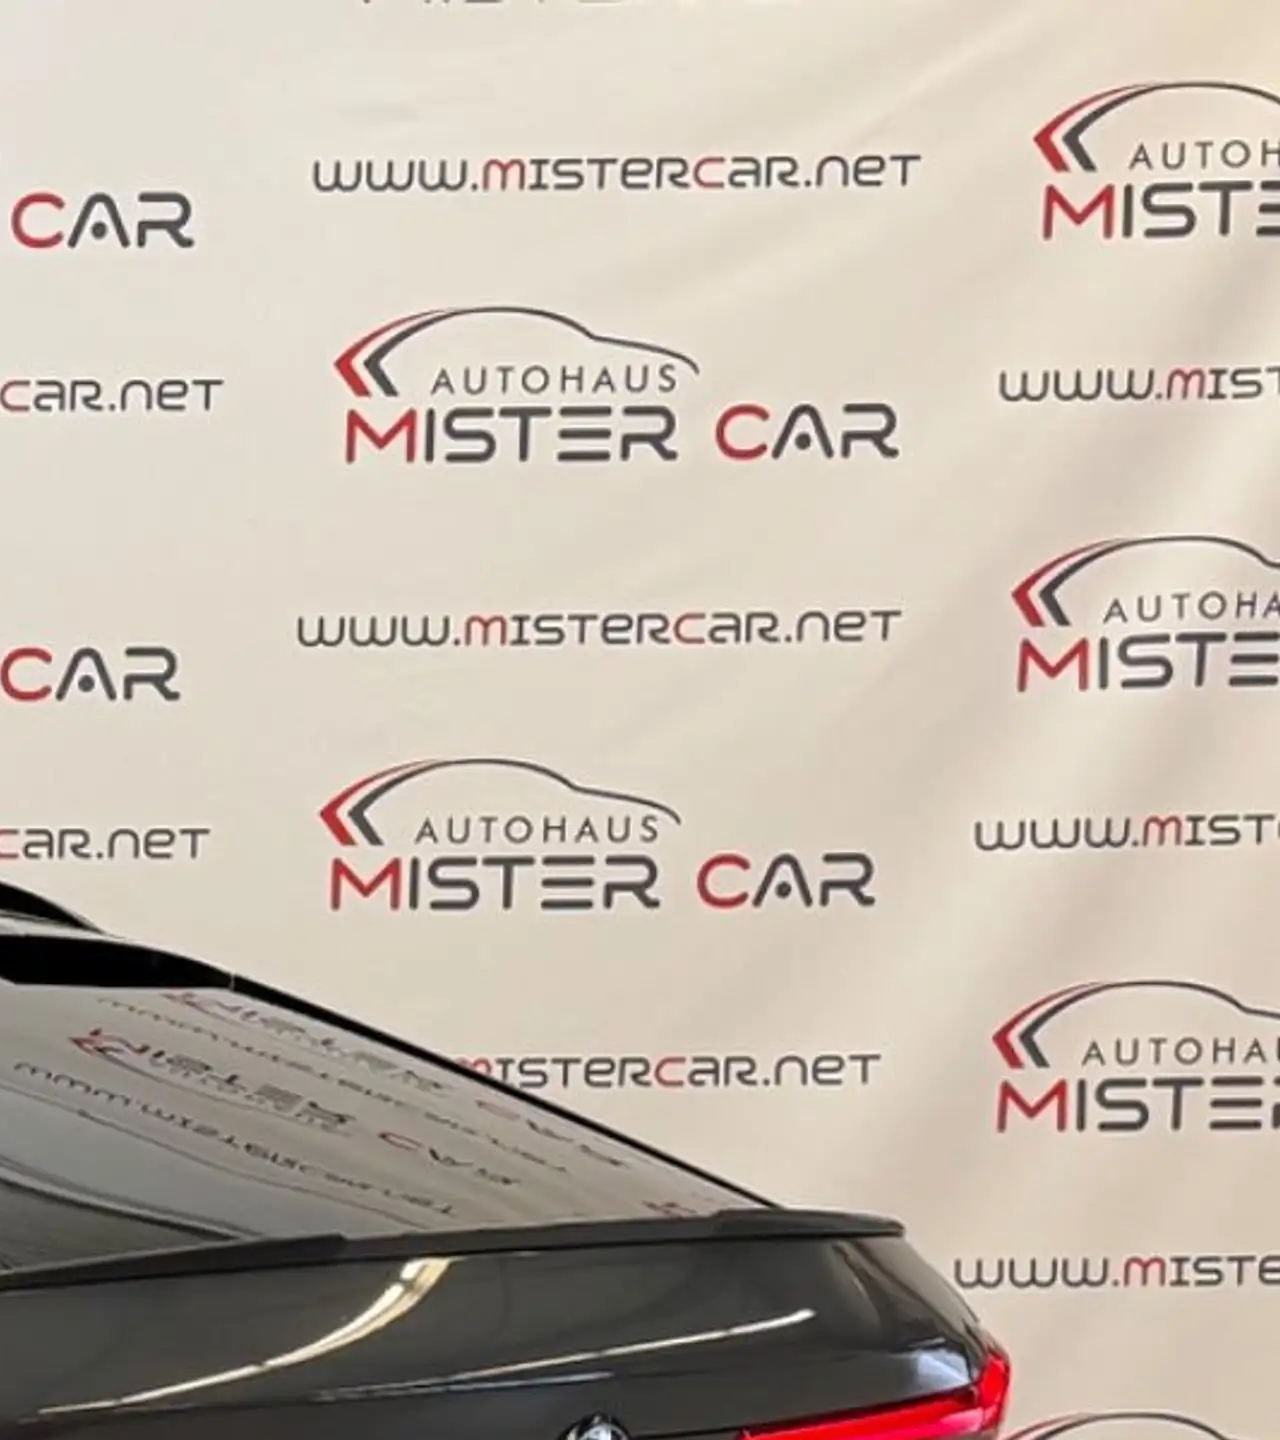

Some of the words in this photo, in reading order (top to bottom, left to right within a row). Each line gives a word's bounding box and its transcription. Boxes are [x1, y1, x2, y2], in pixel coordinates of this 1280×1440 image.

[9, 190, 196, 251] CAR
[430, 363, 677, 396] AUTOHAUS
[344, 404, 680, 466] MISTER
[713, 401, 901, 462] CAR
[414, 813, 659, 845] AUTOHAUS
[329, 853, 662, 913] MISTER
[695, 851, 877, 911] CAR
[1081, 1036, 1280, 1066] AUTOHA
[995, 1074, 1280, 1135] MISTE
